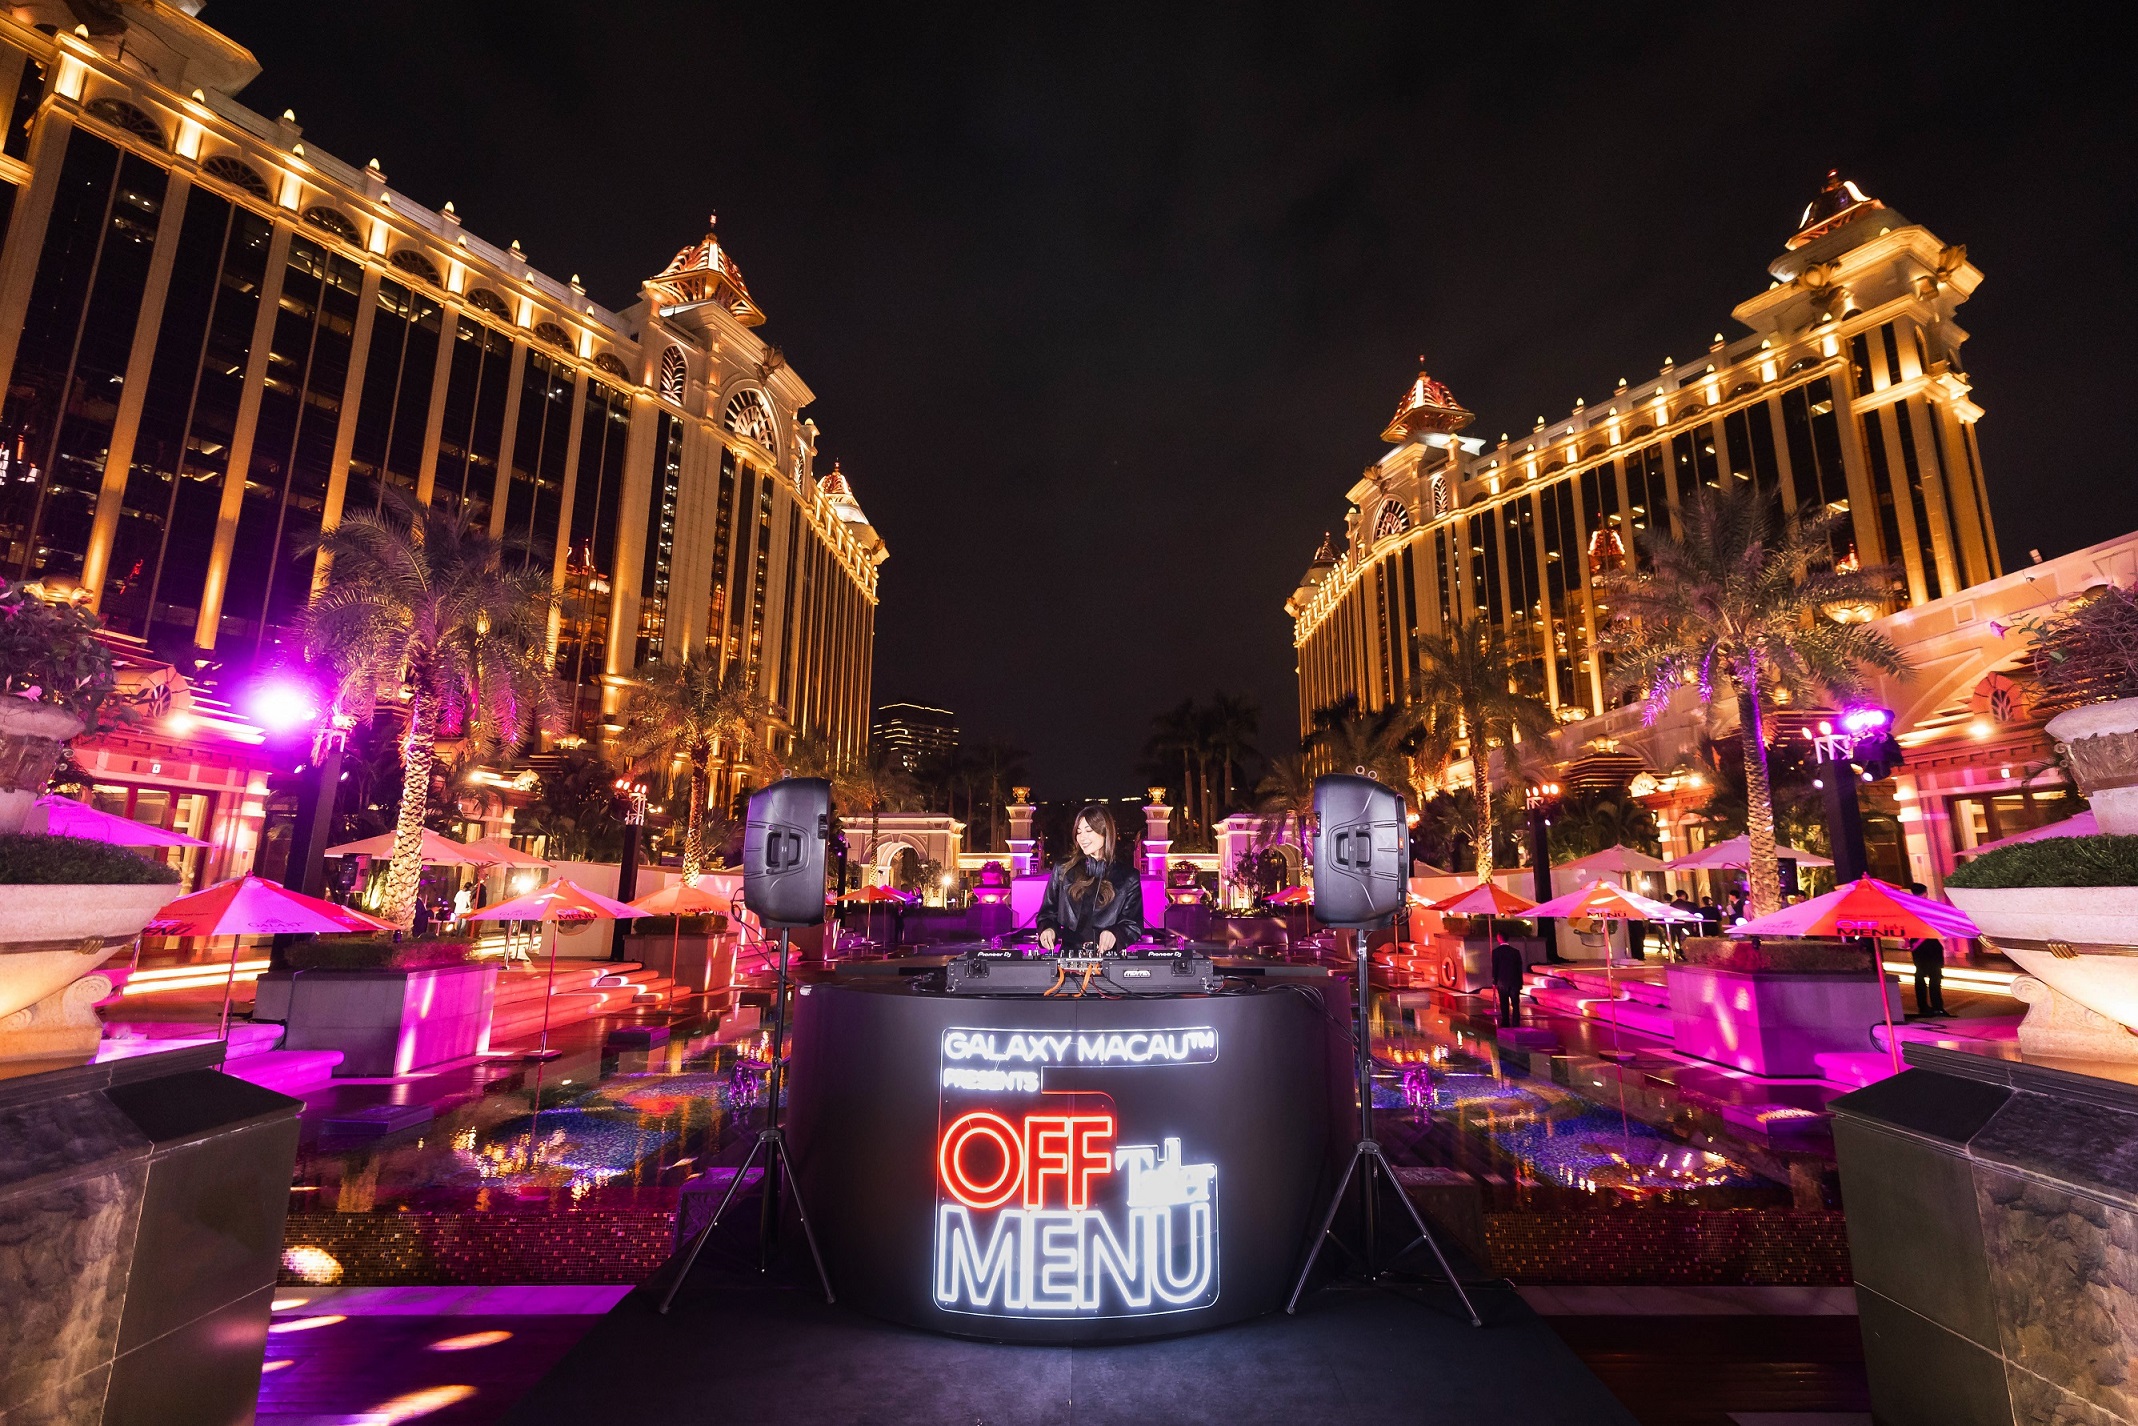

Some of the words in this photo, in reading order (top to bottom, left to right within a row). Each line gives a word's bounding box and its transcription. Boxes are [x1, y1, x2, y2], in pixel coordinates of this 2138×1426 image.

[1836, 920, 1879, 929] OFF
[1837, 928, 1905, 937] MENU
[945, 1032, 1071, 1061] GALAXY
[940, 1112, 1113, 1211] OFF
[938, 1202, 1212, 1310] MENU
